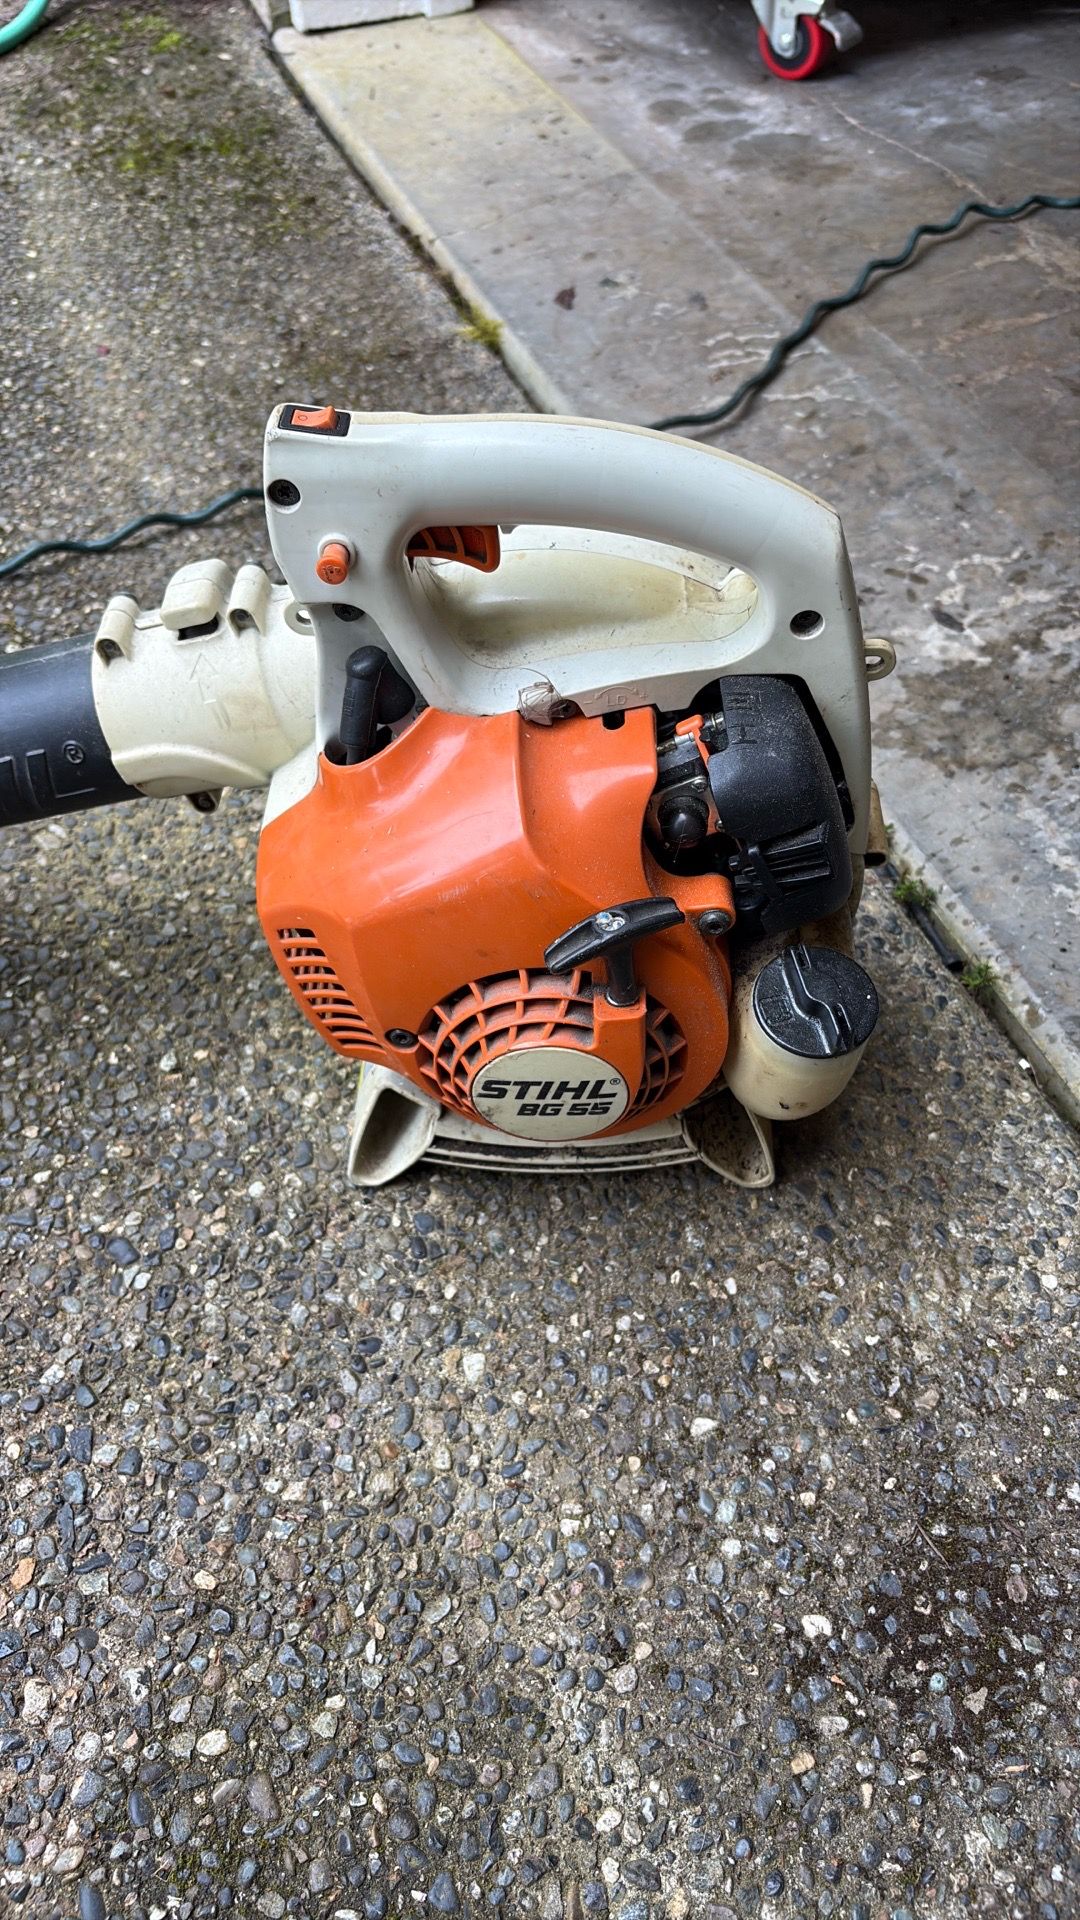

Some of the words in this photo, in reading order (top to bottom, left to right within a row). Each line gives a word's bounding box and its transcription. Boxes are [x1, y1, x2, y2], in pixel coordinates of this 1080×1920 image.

[606, 694, 628, 707] LD
[517, 1103, 564, 1117] BG
[566, 1102, 613, 1116] 55
